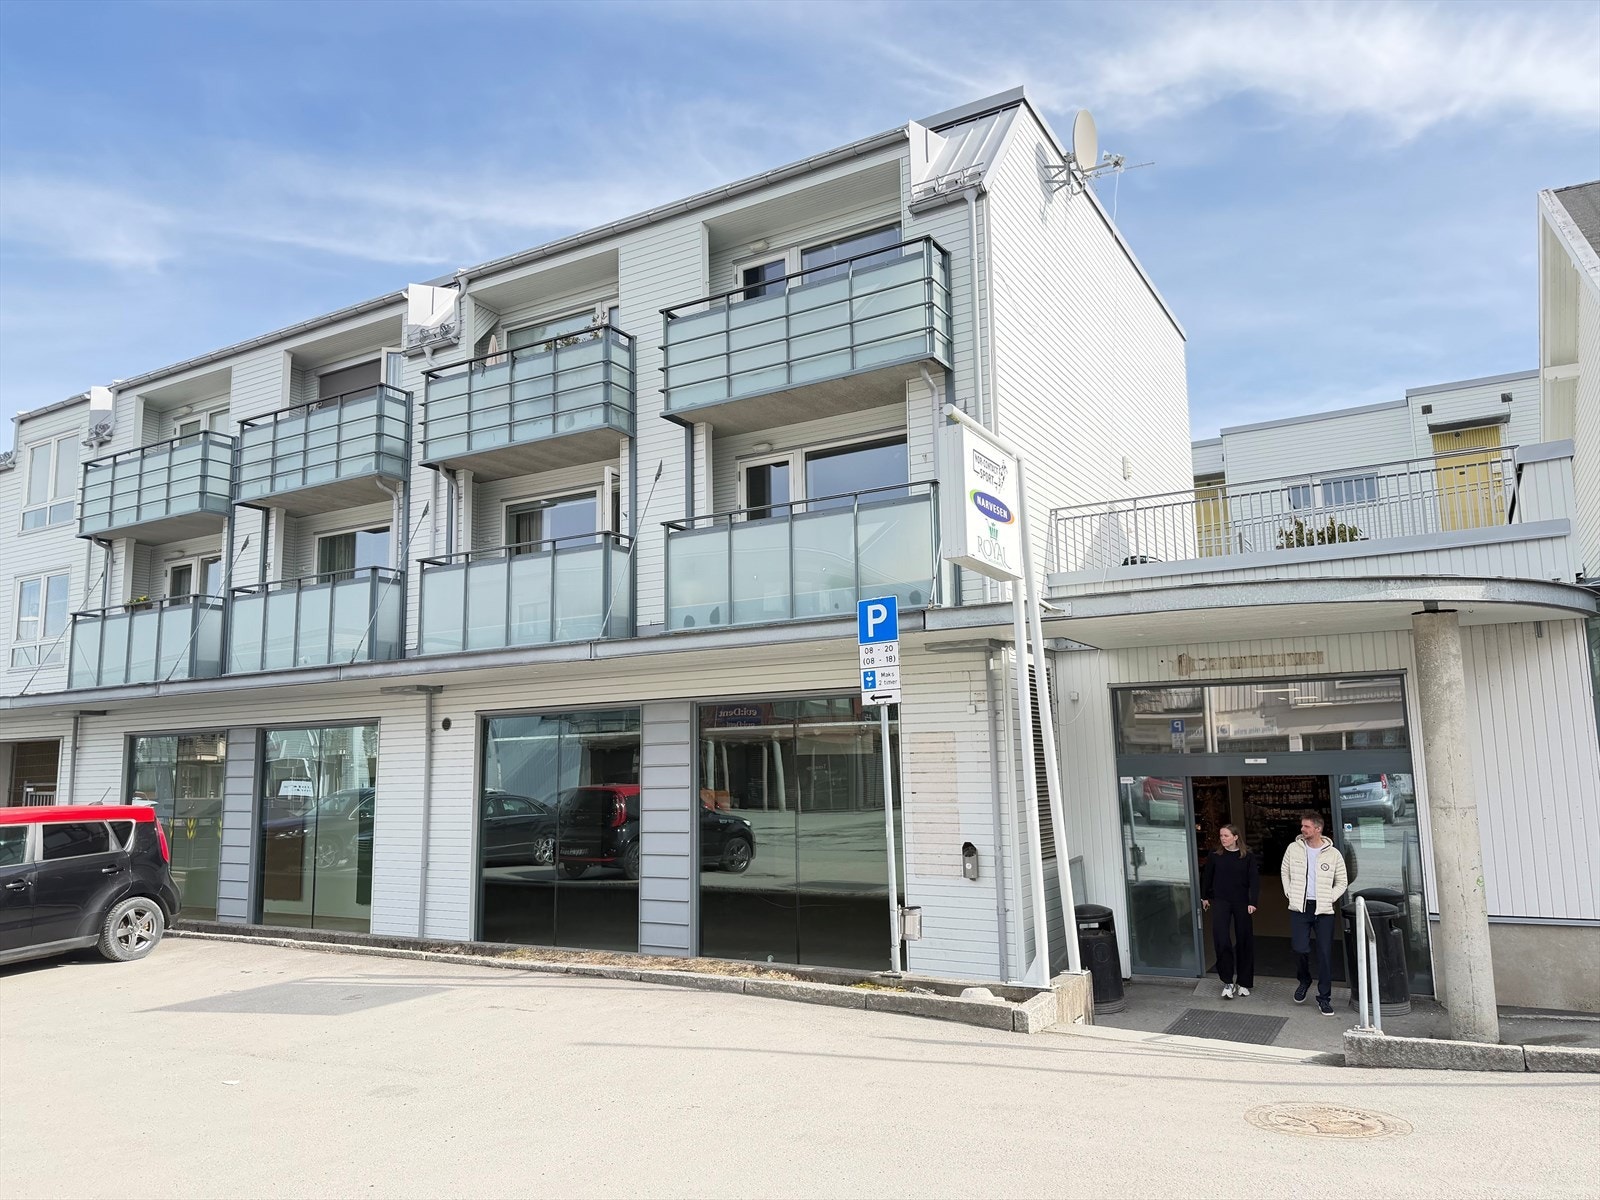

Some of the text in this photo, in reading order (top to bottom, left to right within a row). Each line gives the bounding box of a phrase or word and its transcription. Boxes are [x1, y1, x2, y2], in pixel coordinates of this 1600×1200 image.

[979, 468, 994, 485] SPORT
[976, 495, 1008, 519] NARVESEN
[977, 535, 1012, 569] ROYAL
[867, 604, 887, 637] P
[884, 645, 894, 653] 20
[863, 656, 875, 666] (08
[885, 654, 896, 663] 18)
